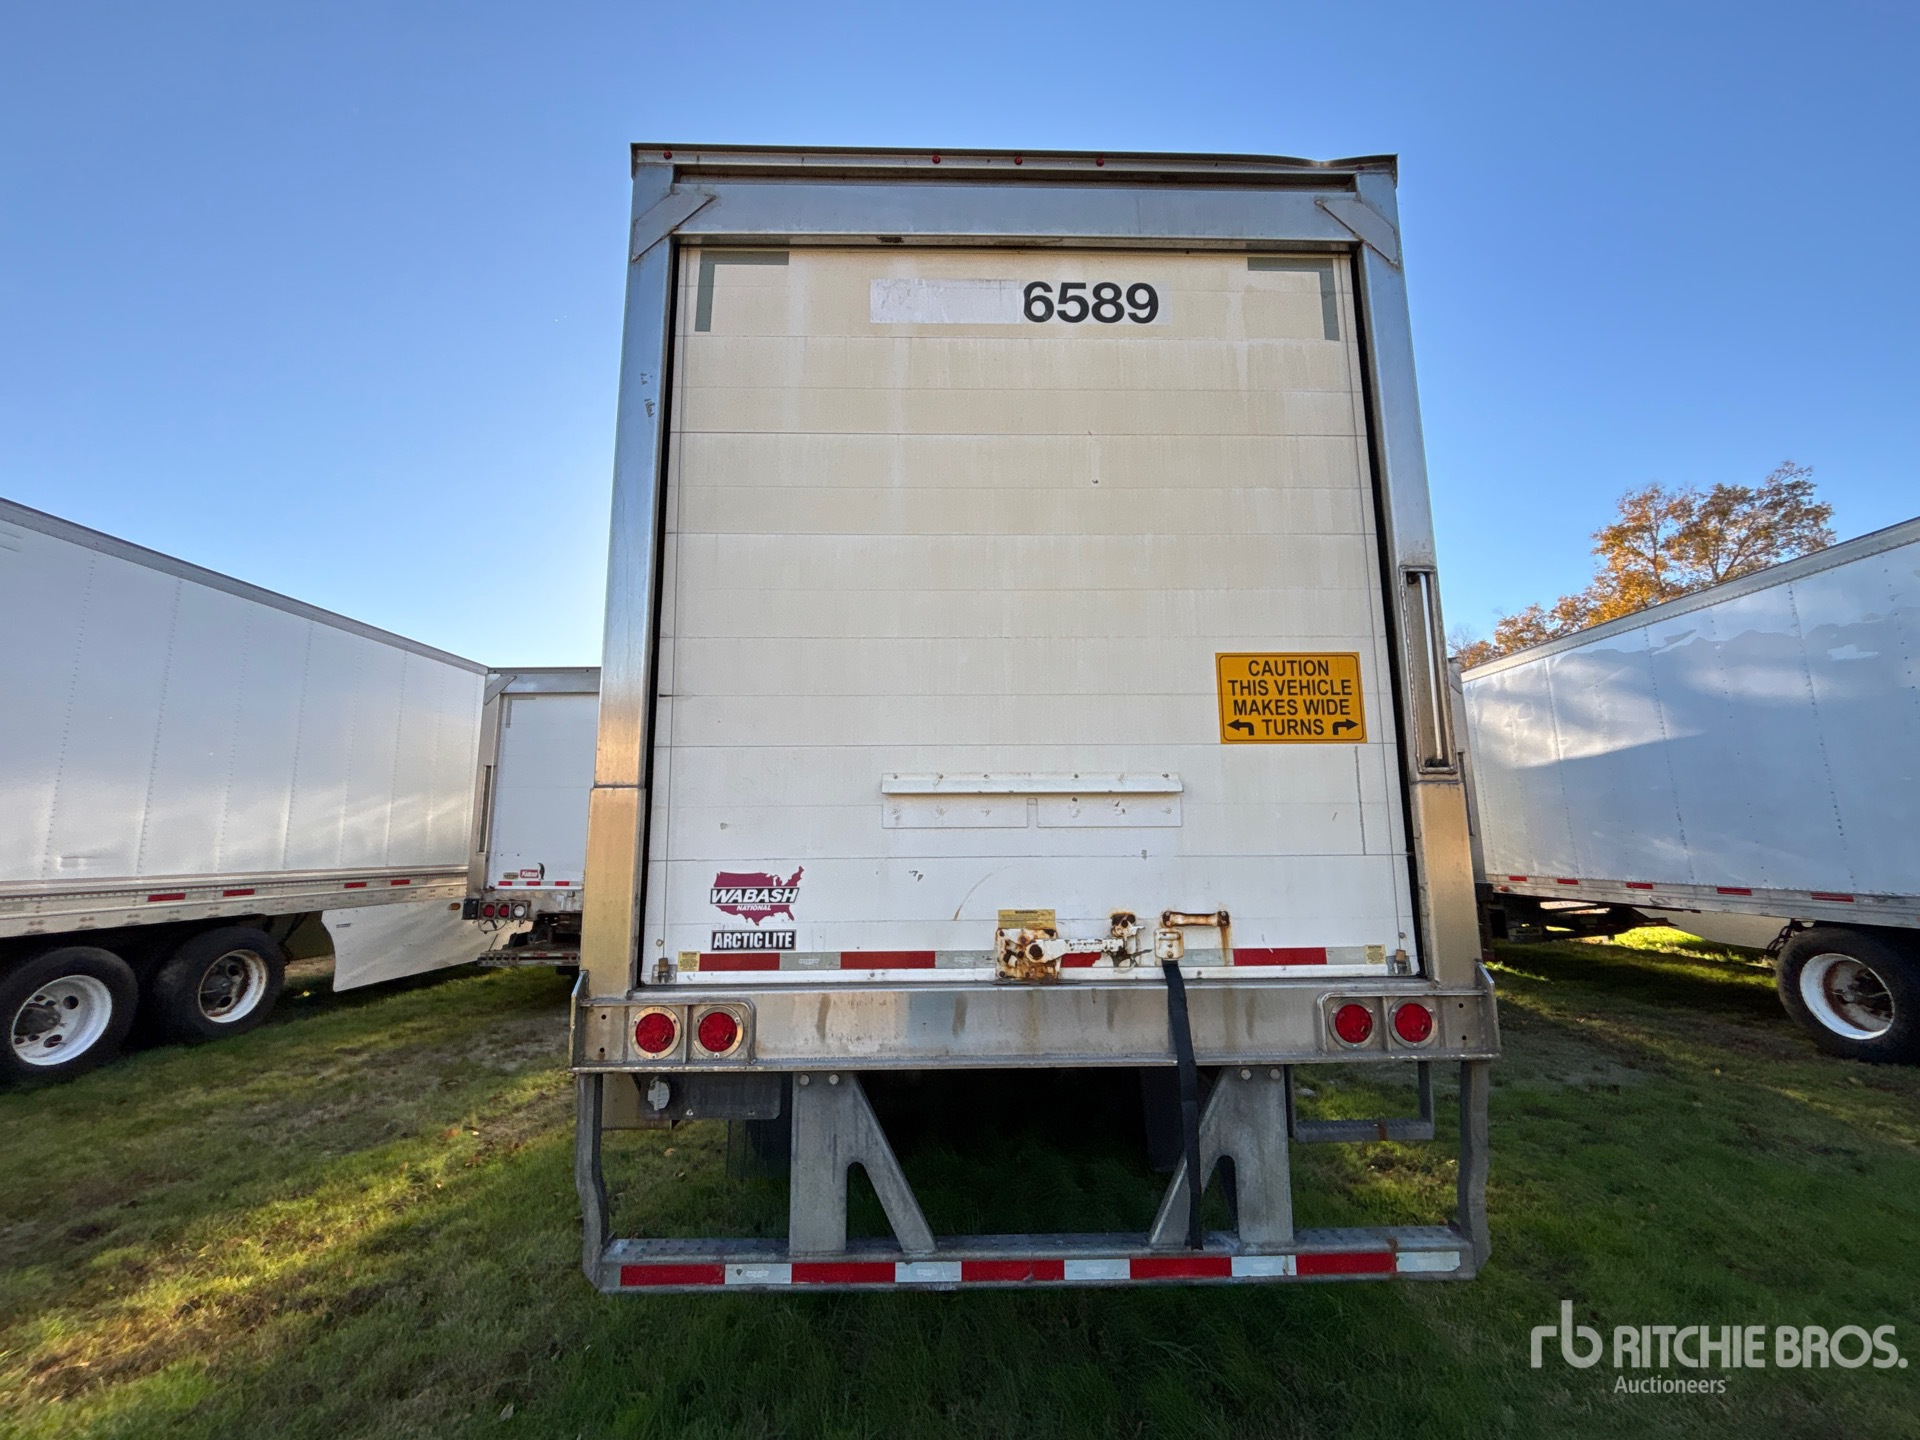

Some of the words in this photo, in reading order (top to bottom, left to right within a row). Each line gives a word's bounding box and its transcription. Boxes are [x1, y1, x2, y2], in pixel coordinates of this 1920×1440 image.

[1023, 281, 1159, 323] 6589
[1248, 660, 1329, 676] CAUTION
[1228, 680, 1269, 696] THIS
[1274, 679, 1352, 696] VEHICLE
[1233, 699, 1298, 716] MAKES
[1303, 699, 1350, 716] WIDE
[1262, 719, 1324, 735] TURNS
[711, 888, 798, 903] WABASH
[713, 932, 763, 949] ARCTIC
[765, 932, 792, 948] LITE
